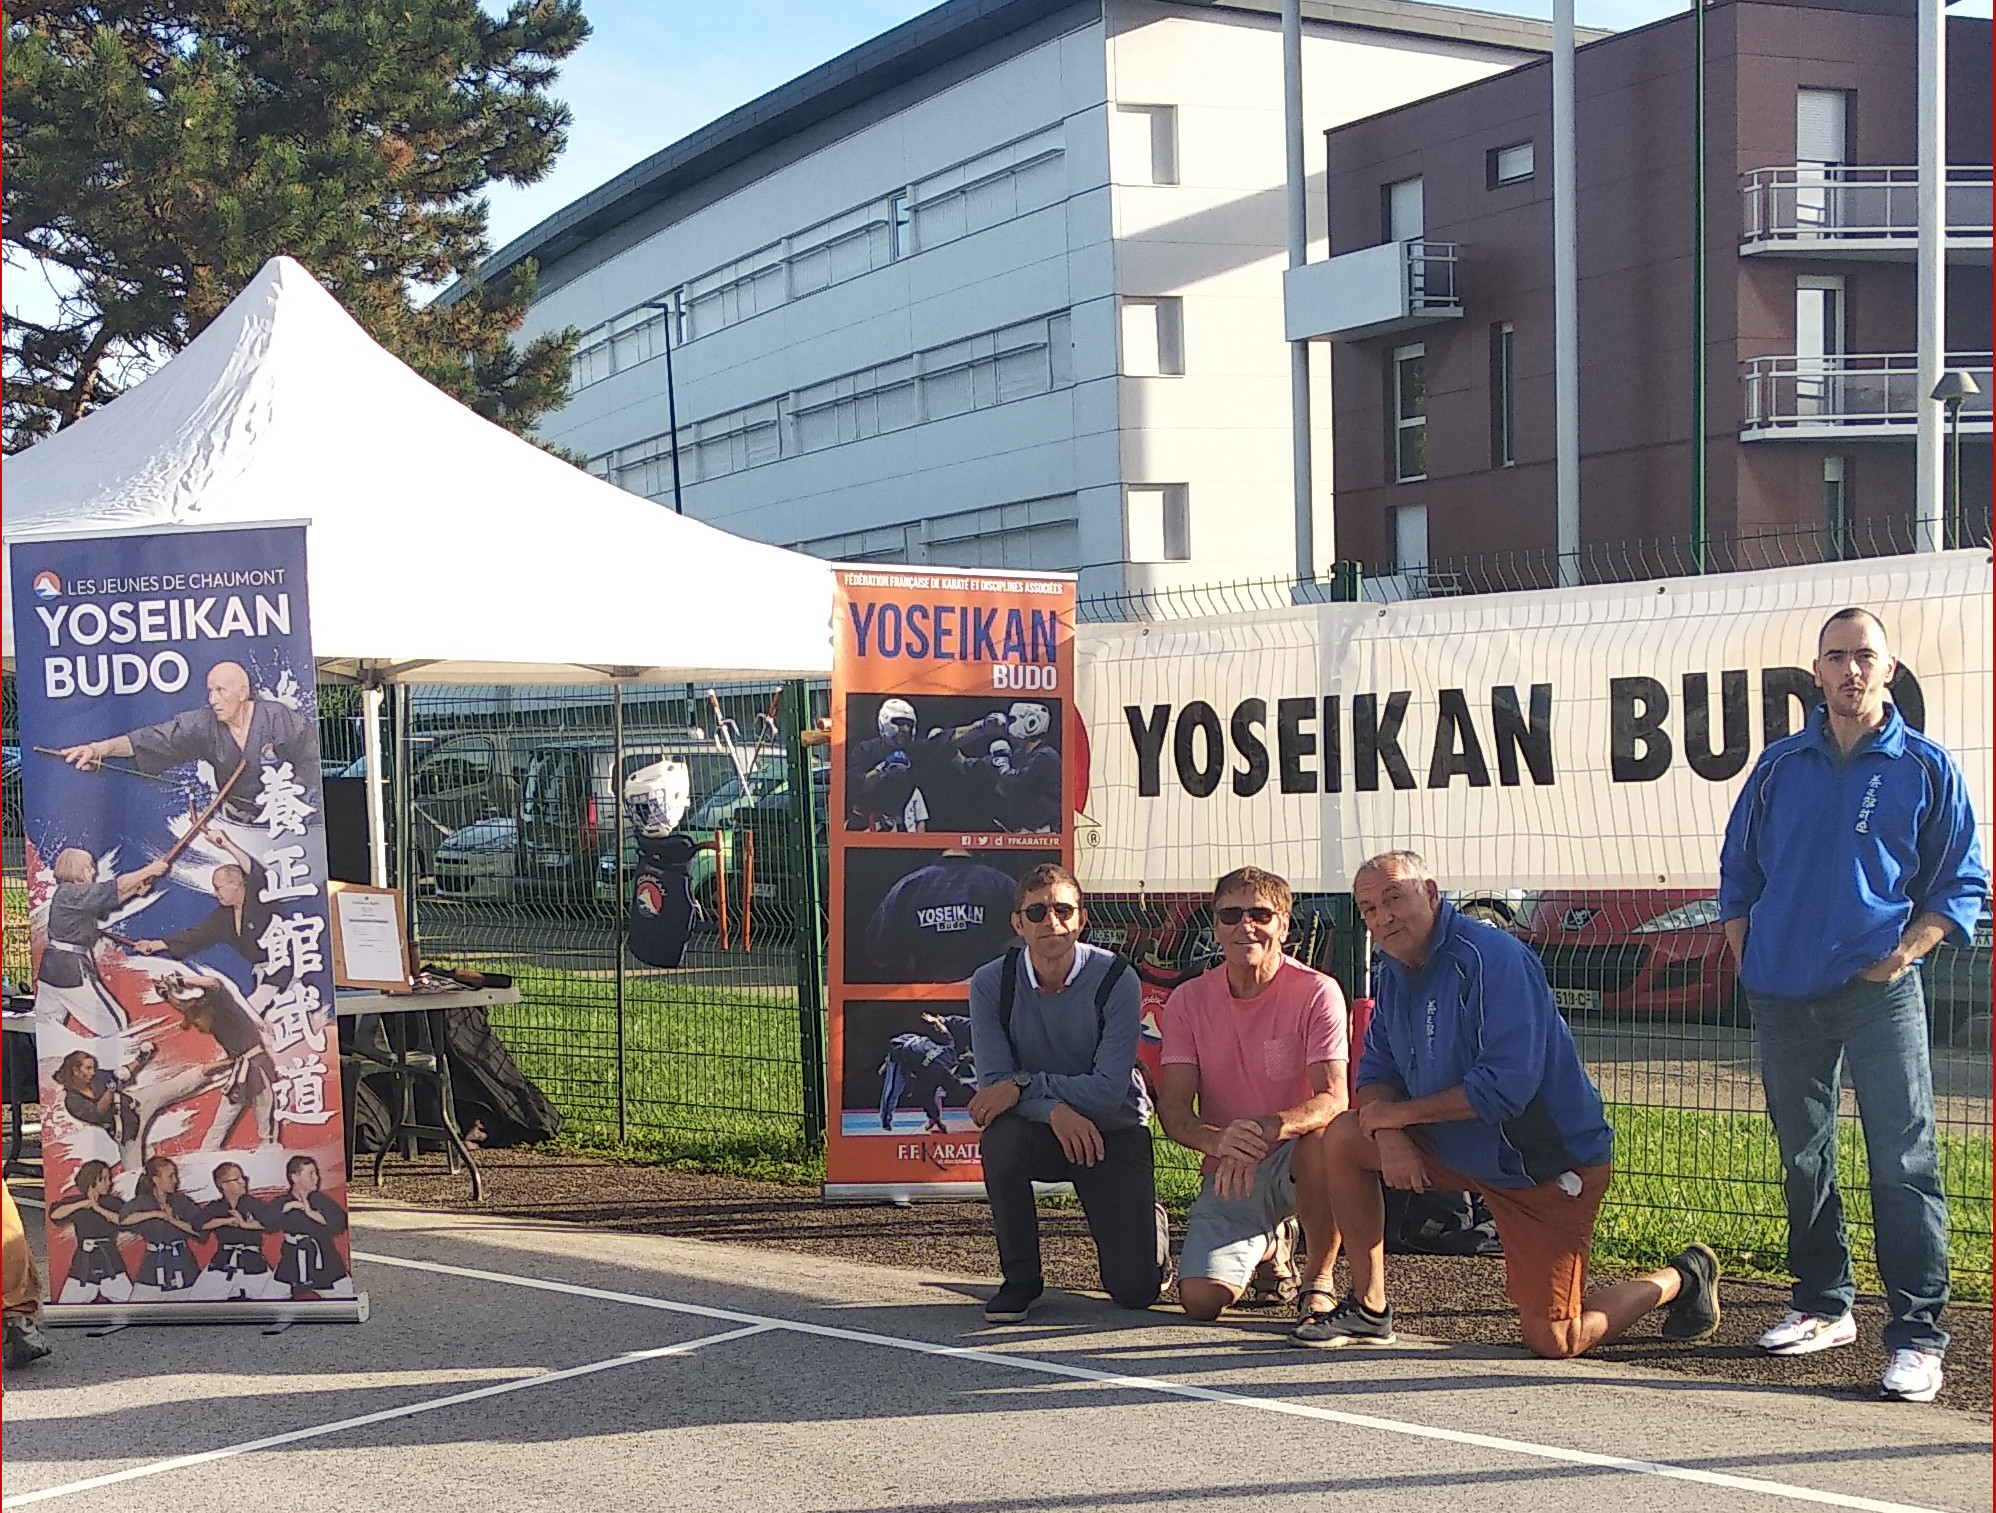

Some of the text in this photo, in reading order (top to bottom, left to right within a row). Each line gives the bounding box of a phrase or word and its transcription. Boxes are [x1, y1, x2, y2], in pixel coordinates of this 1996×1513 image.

[67, 568, 285, 596] LES JEUNES DE CHAUMONT
[971, 580, 979, 591] ET
[35, 594, 291, 647] YOSEIKAN
[848, 602, 1057, 663] YOSEIKAN
[45, 651, 190, 698] BUDO
[993, 664, 1058, 690] BUDO
[1124, 683, 1556, 798] YOSEIKAN
[916, 904, 984, 925] YOSEIKAN
